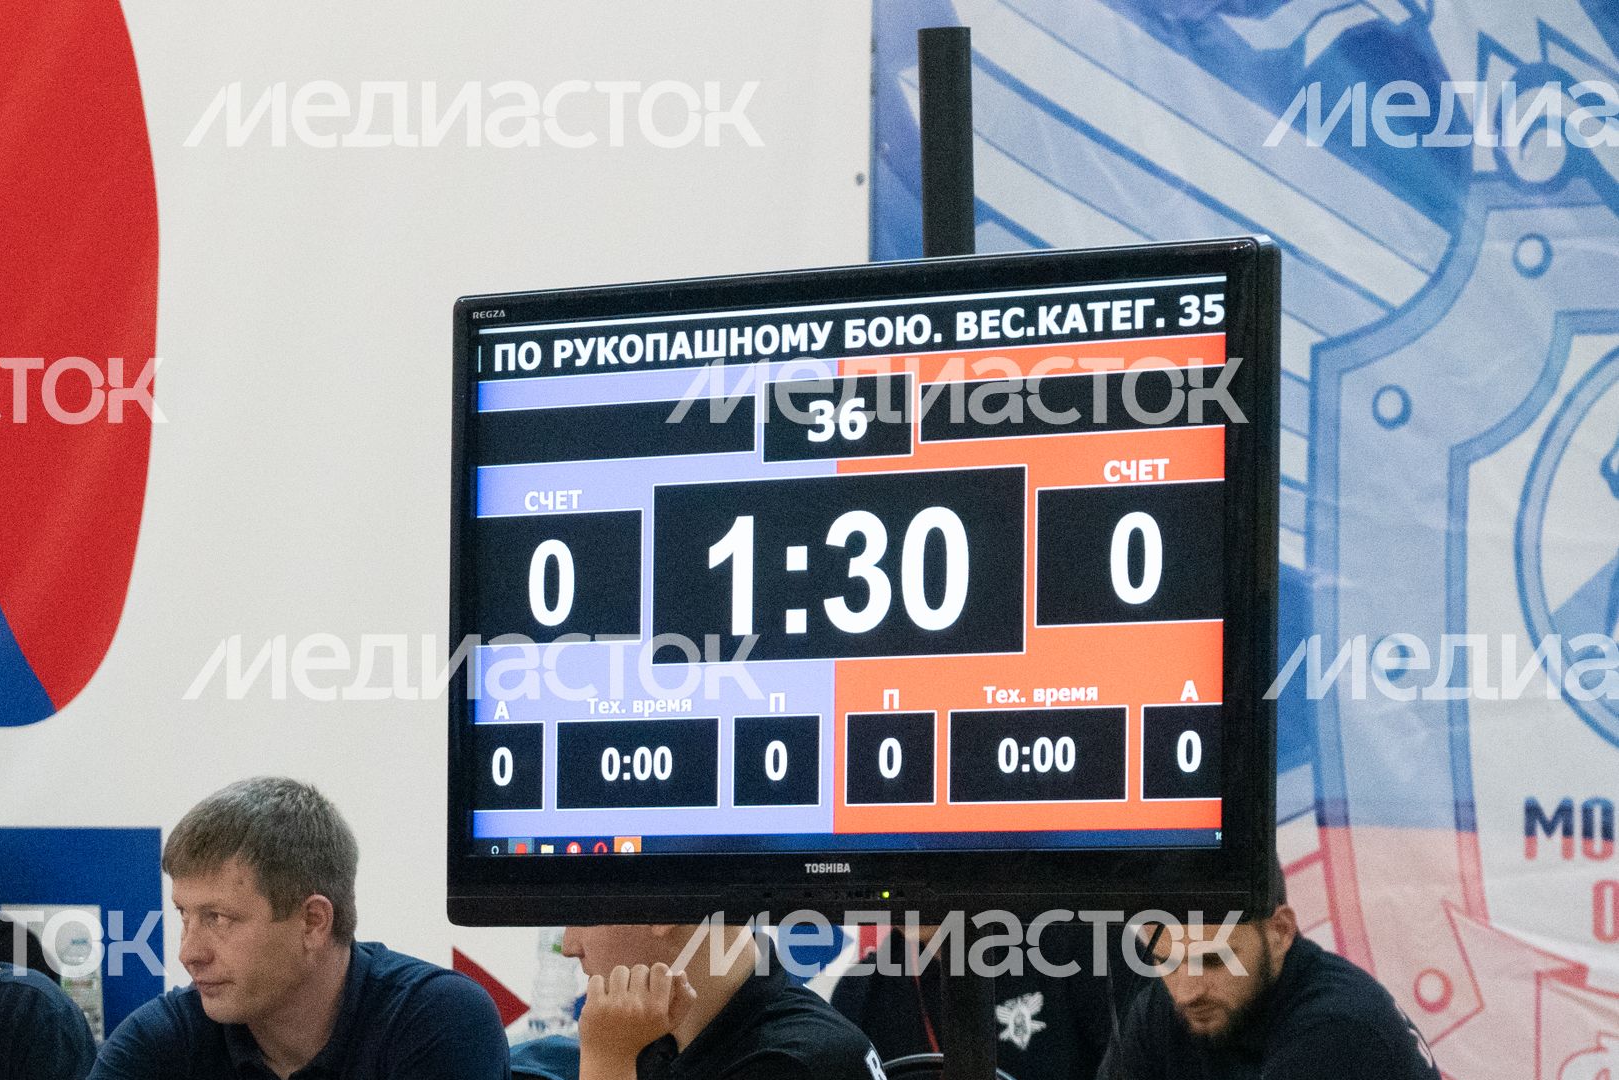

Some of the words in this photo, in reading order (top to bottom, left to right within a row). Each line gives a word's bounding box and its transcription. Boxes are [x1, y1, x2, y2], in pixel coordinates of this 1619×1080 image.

[472, 309, 506, 320] REGZA
[493, 341, 543, 374] ПО
[552, 321, 835, 369] РУКОПАШНОМУ
[844, 315, 943, 350] БОЮ.
[1178, 295, 1226, 328] 35
[807, 399, 869, 443] 36
[1104, 458, 1170, 483] СЧЕТ
[524, 489, 583, 512] СЧЕТ
[708, 506, 970, 636] 1:30
[1109, 511, 1164, 605] 0
[528, 538, 575, 627] 0
[587, 697, 627, 715] Тех.
[632, 698, 693, 718] время
[768, 692, 786, 713] П
[882, 688, 901, 710] П
[983, 686, 1027, 704] Тех.
[1032, 685, 1100, 707] время
[1179, 679, 1200, 702] А
[493, 700, 511, 721] А
[491, 746, 514, 787] 0
[600, 745, 674, 782] 0:00
[764, 739, 789, 782] 0
[877, 736, 903, 780] 0
[996, 735, 1077, 775] 0:00
[1176, 729, 1203, 774] 0
[804, 862, 852, 874] TOSHIBA
